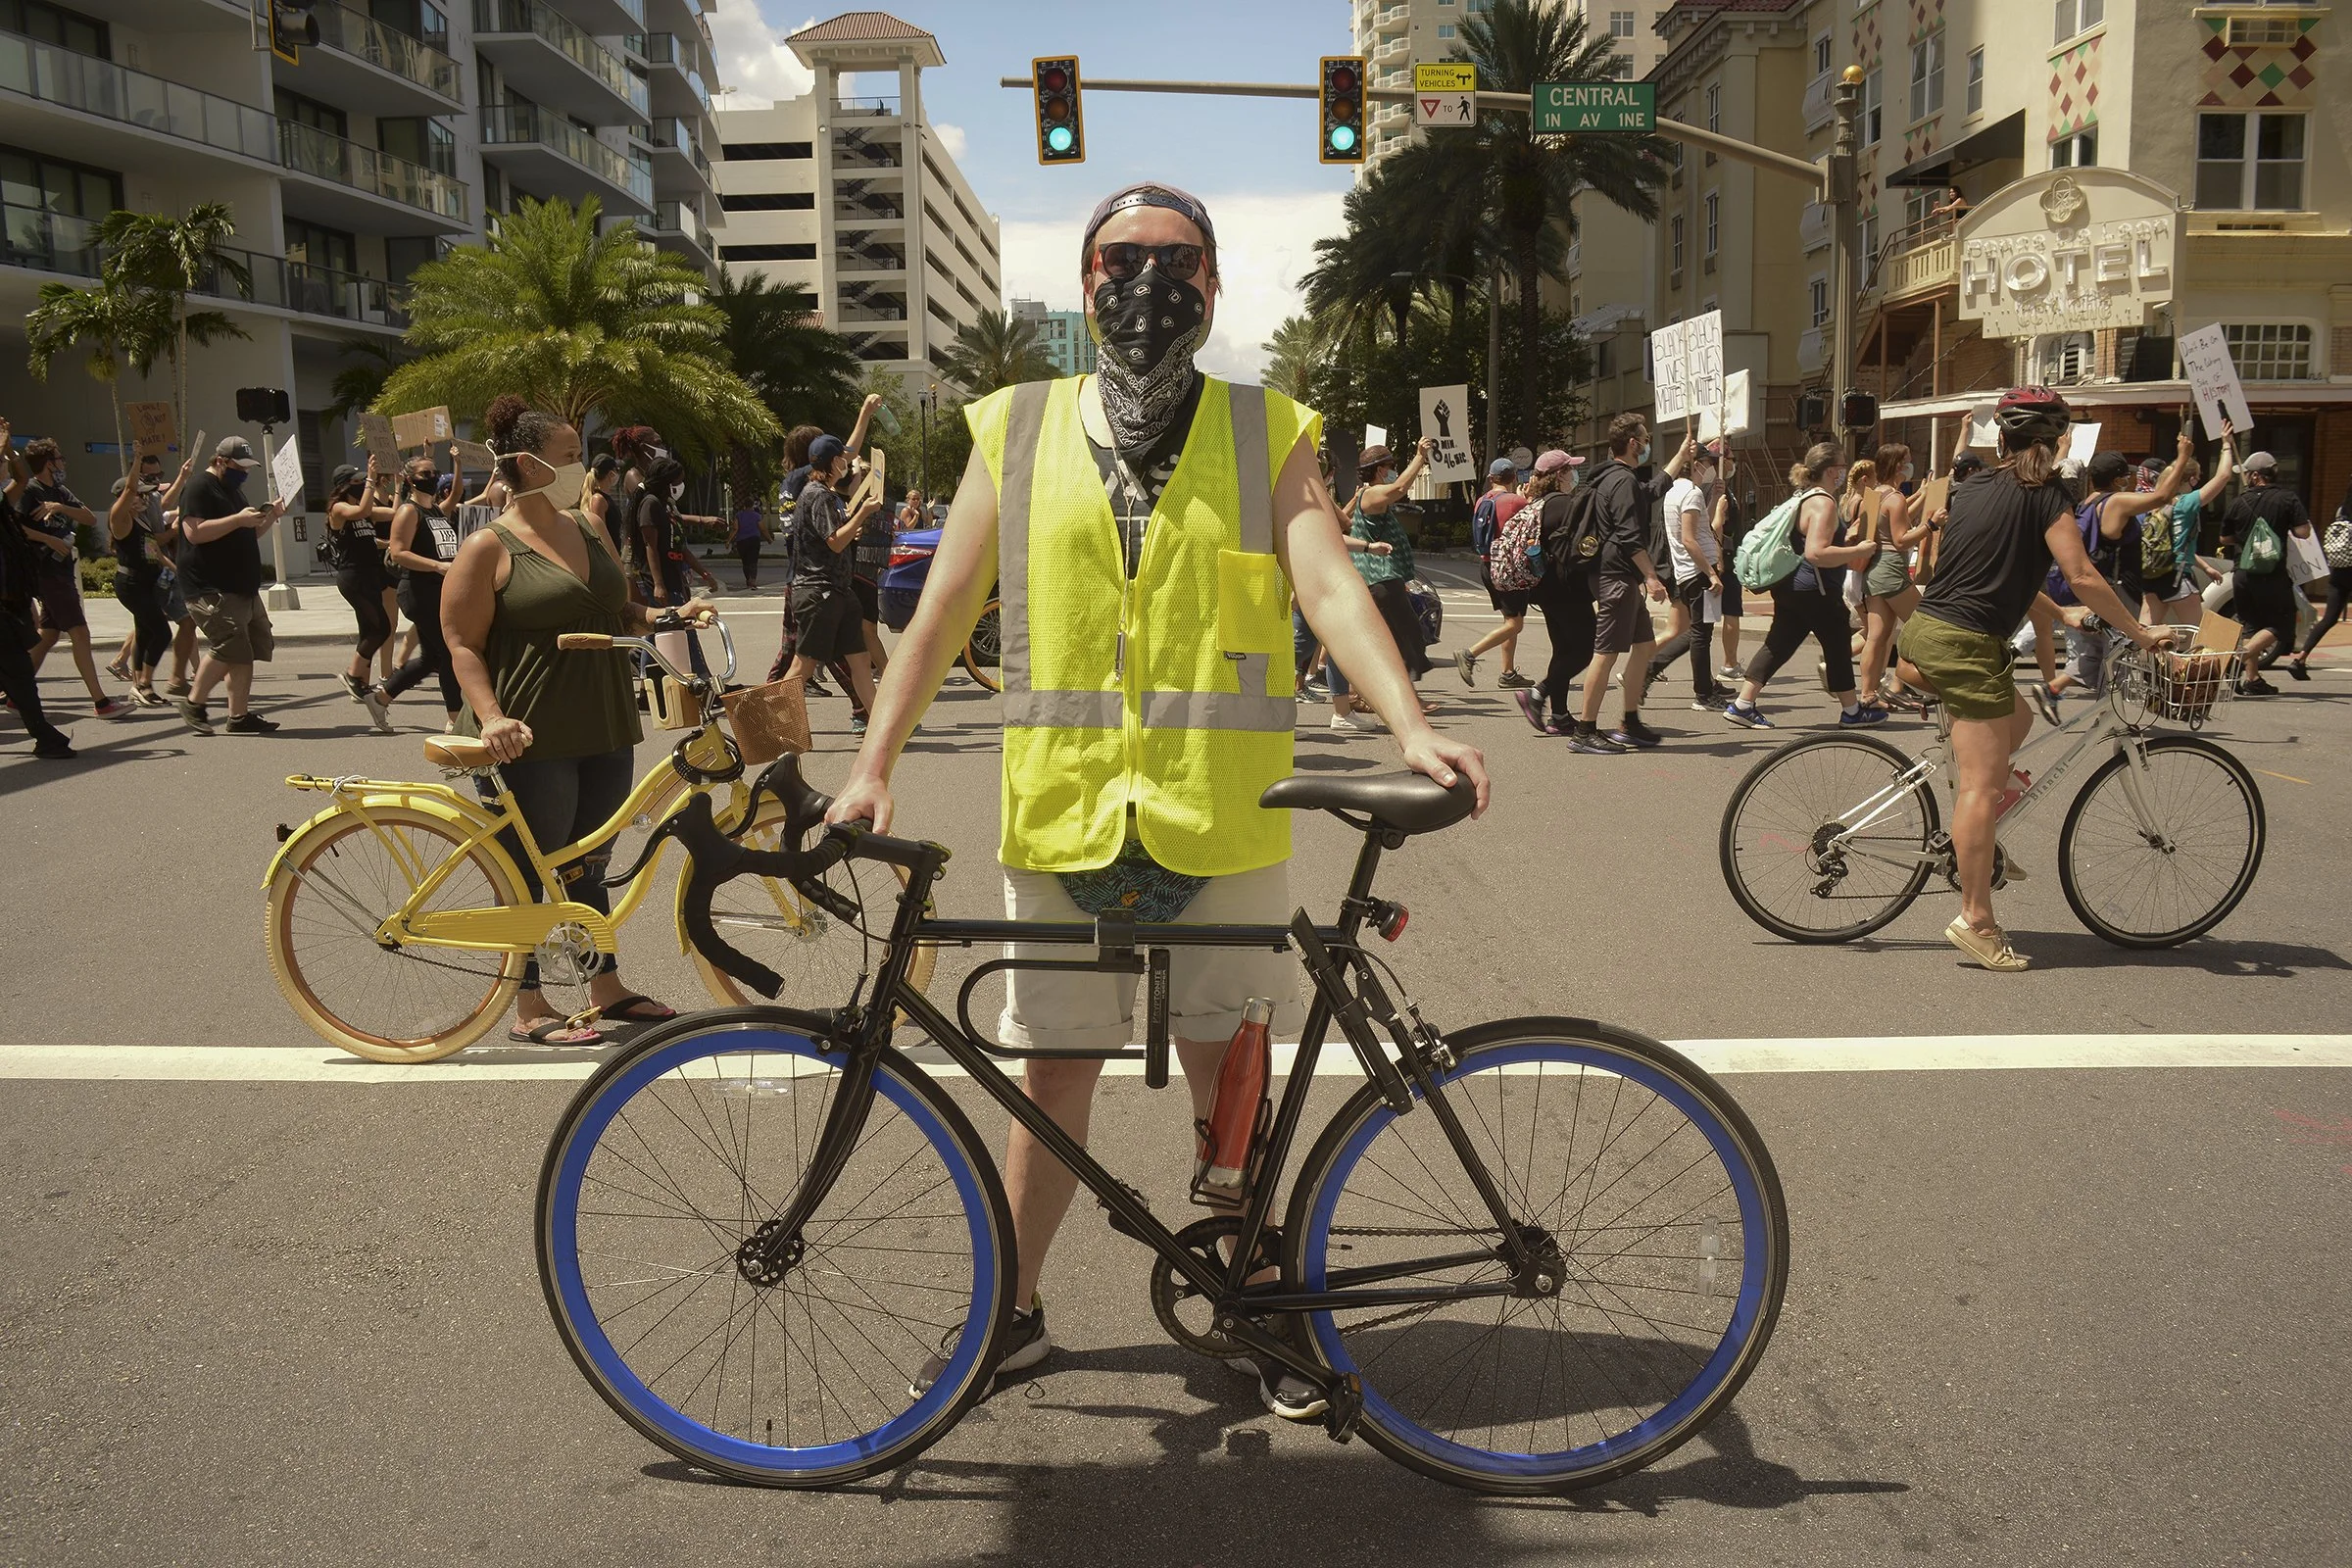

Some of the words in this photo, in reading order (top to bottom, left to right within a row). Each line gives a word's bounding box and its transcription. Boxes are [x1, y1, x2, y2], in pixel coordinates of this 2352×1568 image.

[1549, 87, 1641, 106] CENTRAL
[1544, 113, 1561, 127] 1N
[1579, 113, 1601, 127] AV
[1618, 113, 1645, 127] 1NE
[1963, 239, 2169, 296] HOTEL
[1687, 316, 1722, 353] BLACK
[1689, 344, 1723, 376] LIVES
[1431, 438, 1444, 463] 8
[1152, 969, 1161, 1024] KRYPTONITE
